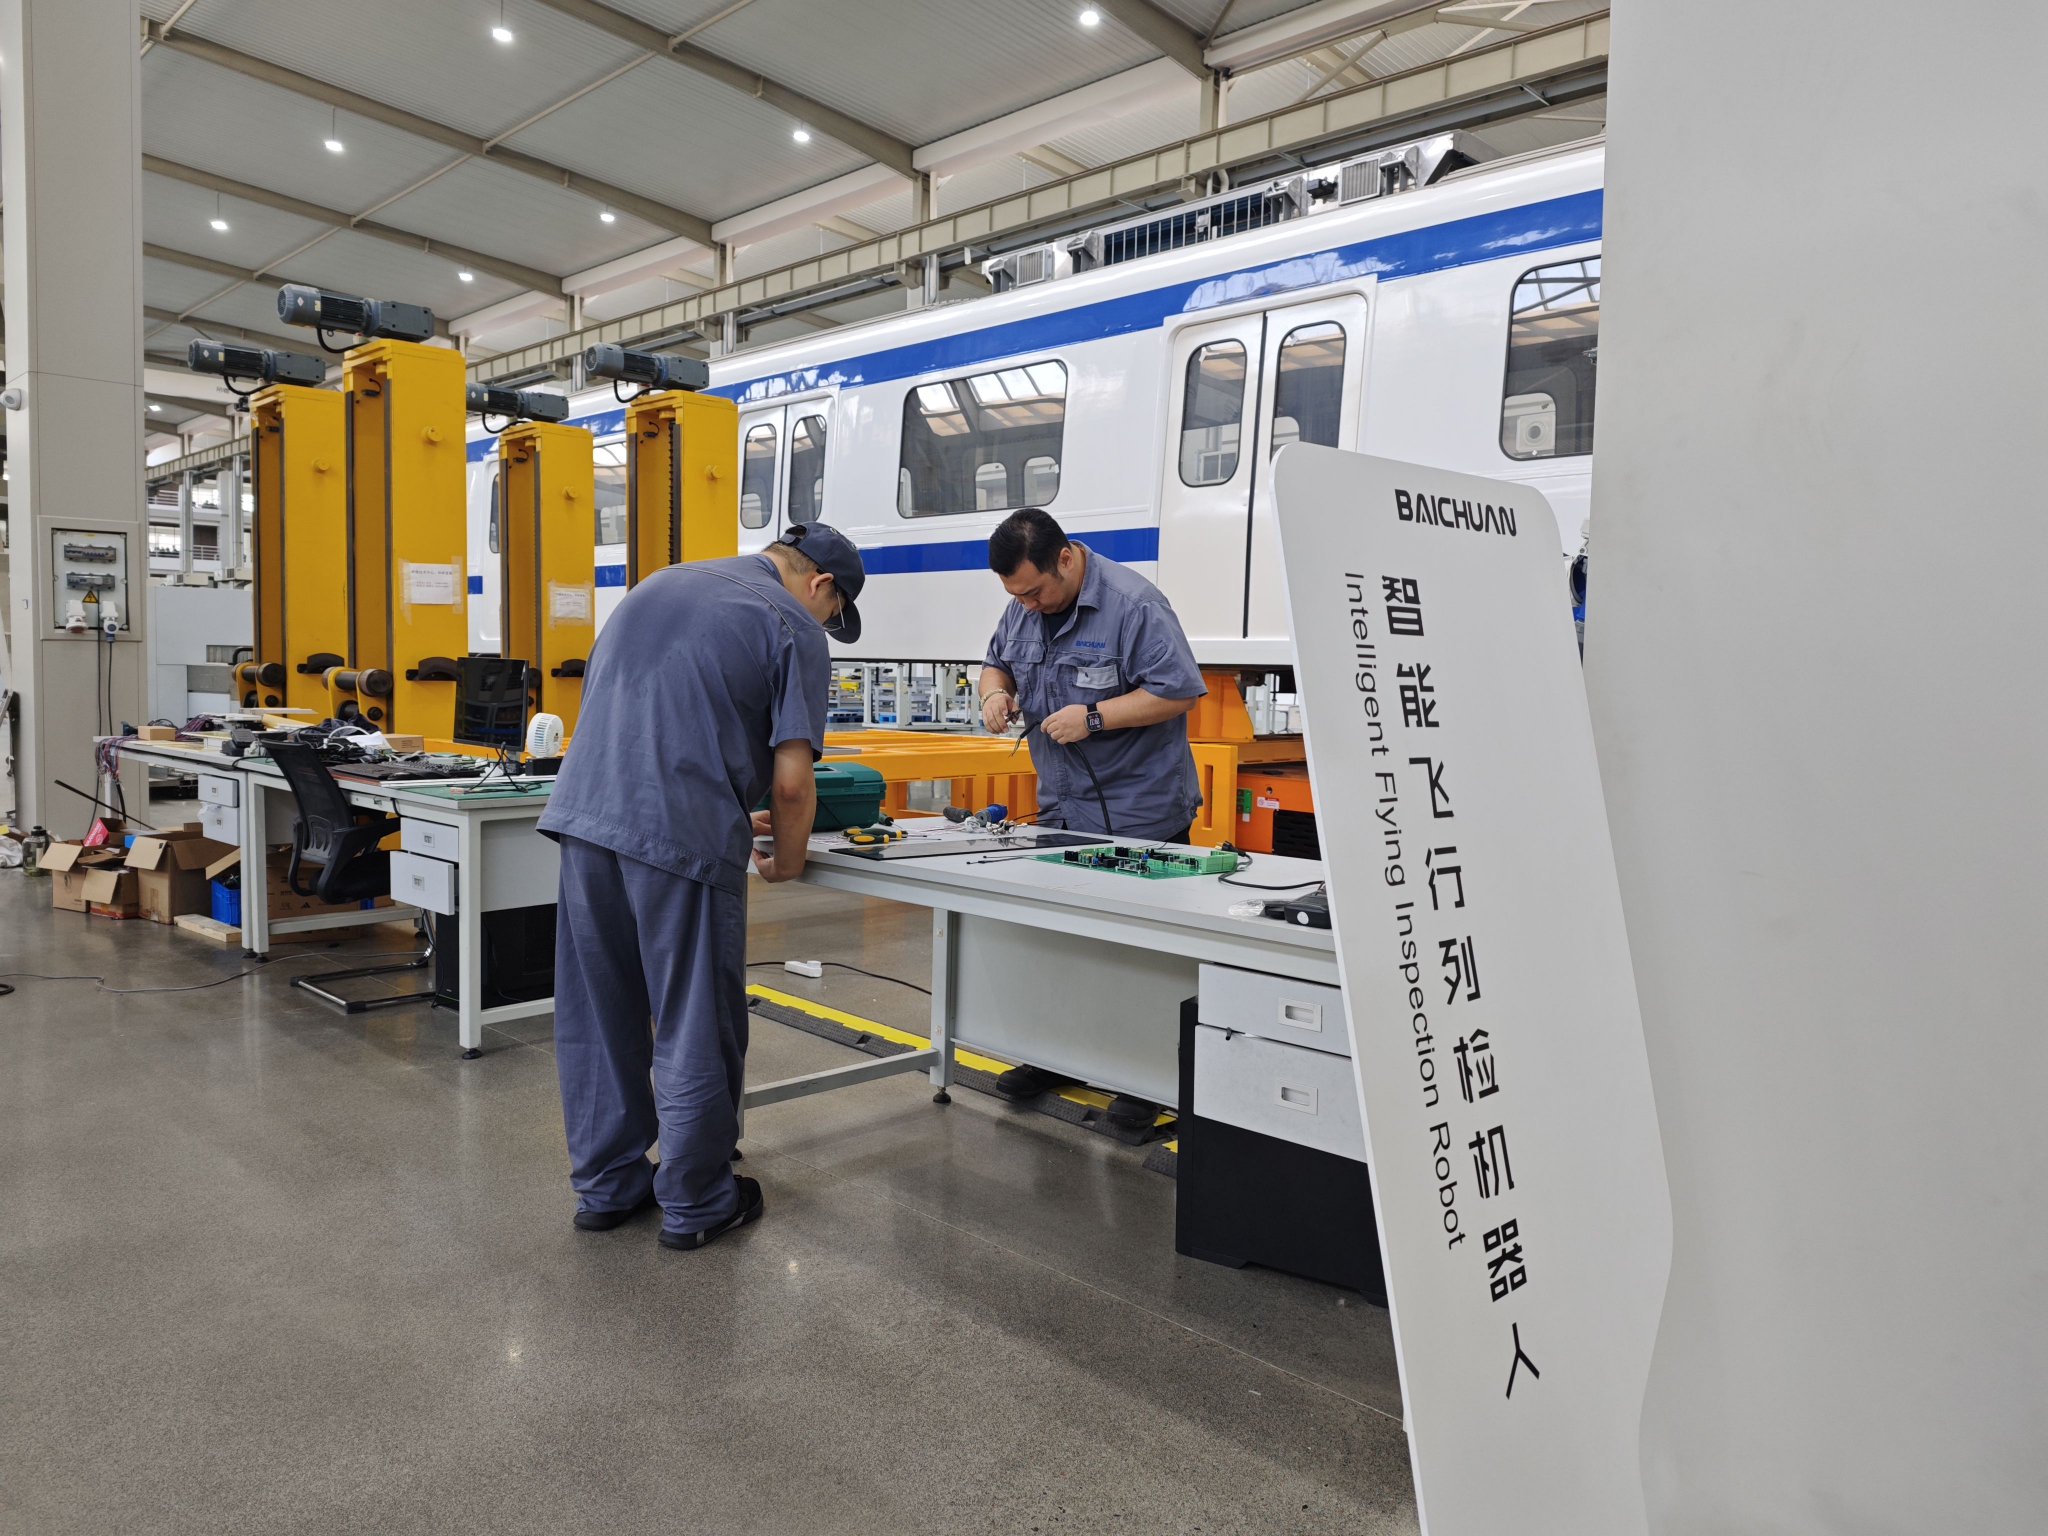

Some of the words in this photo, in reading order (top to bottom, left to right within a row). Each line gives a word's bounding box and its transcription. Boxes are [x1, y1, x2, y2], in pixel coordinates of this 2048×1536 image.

[1394, 488, 1517, 537] BAICHUAN
[1344, 572, 1390, 757] Intelligent
[1374, 772, 1406, 887] Flying
[1395, 901, 1439, 1108] Inspection
[1429, 1121, 1466, 1251] Robot
[1381, 575, 1540, 1400] 智能飞行列检机器人
